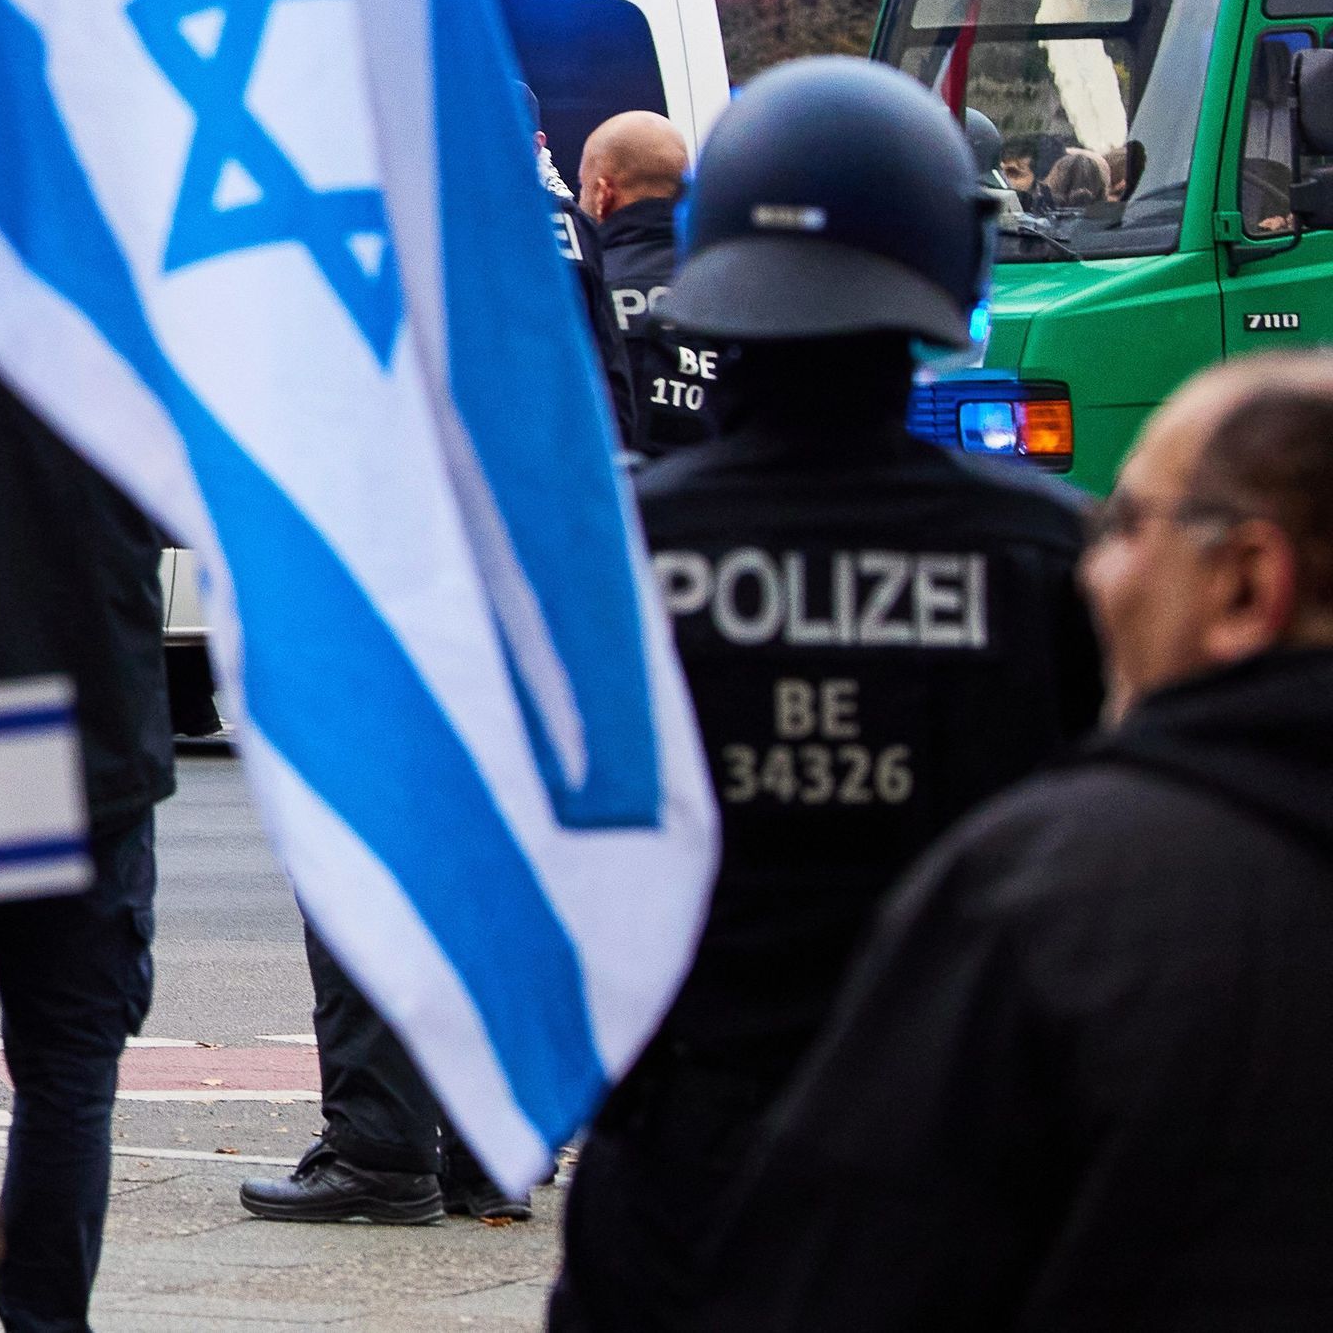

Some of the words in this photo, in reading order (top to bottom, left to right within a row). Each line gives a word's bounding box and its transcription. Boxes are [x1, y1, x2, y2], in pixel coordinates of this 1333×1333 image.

[678, 345, 719, 380] BE
[650, 546, 989, 649] POLIZEI
[773, 676, 862, 740] BE
[722, 742, 914, 805] 34326
